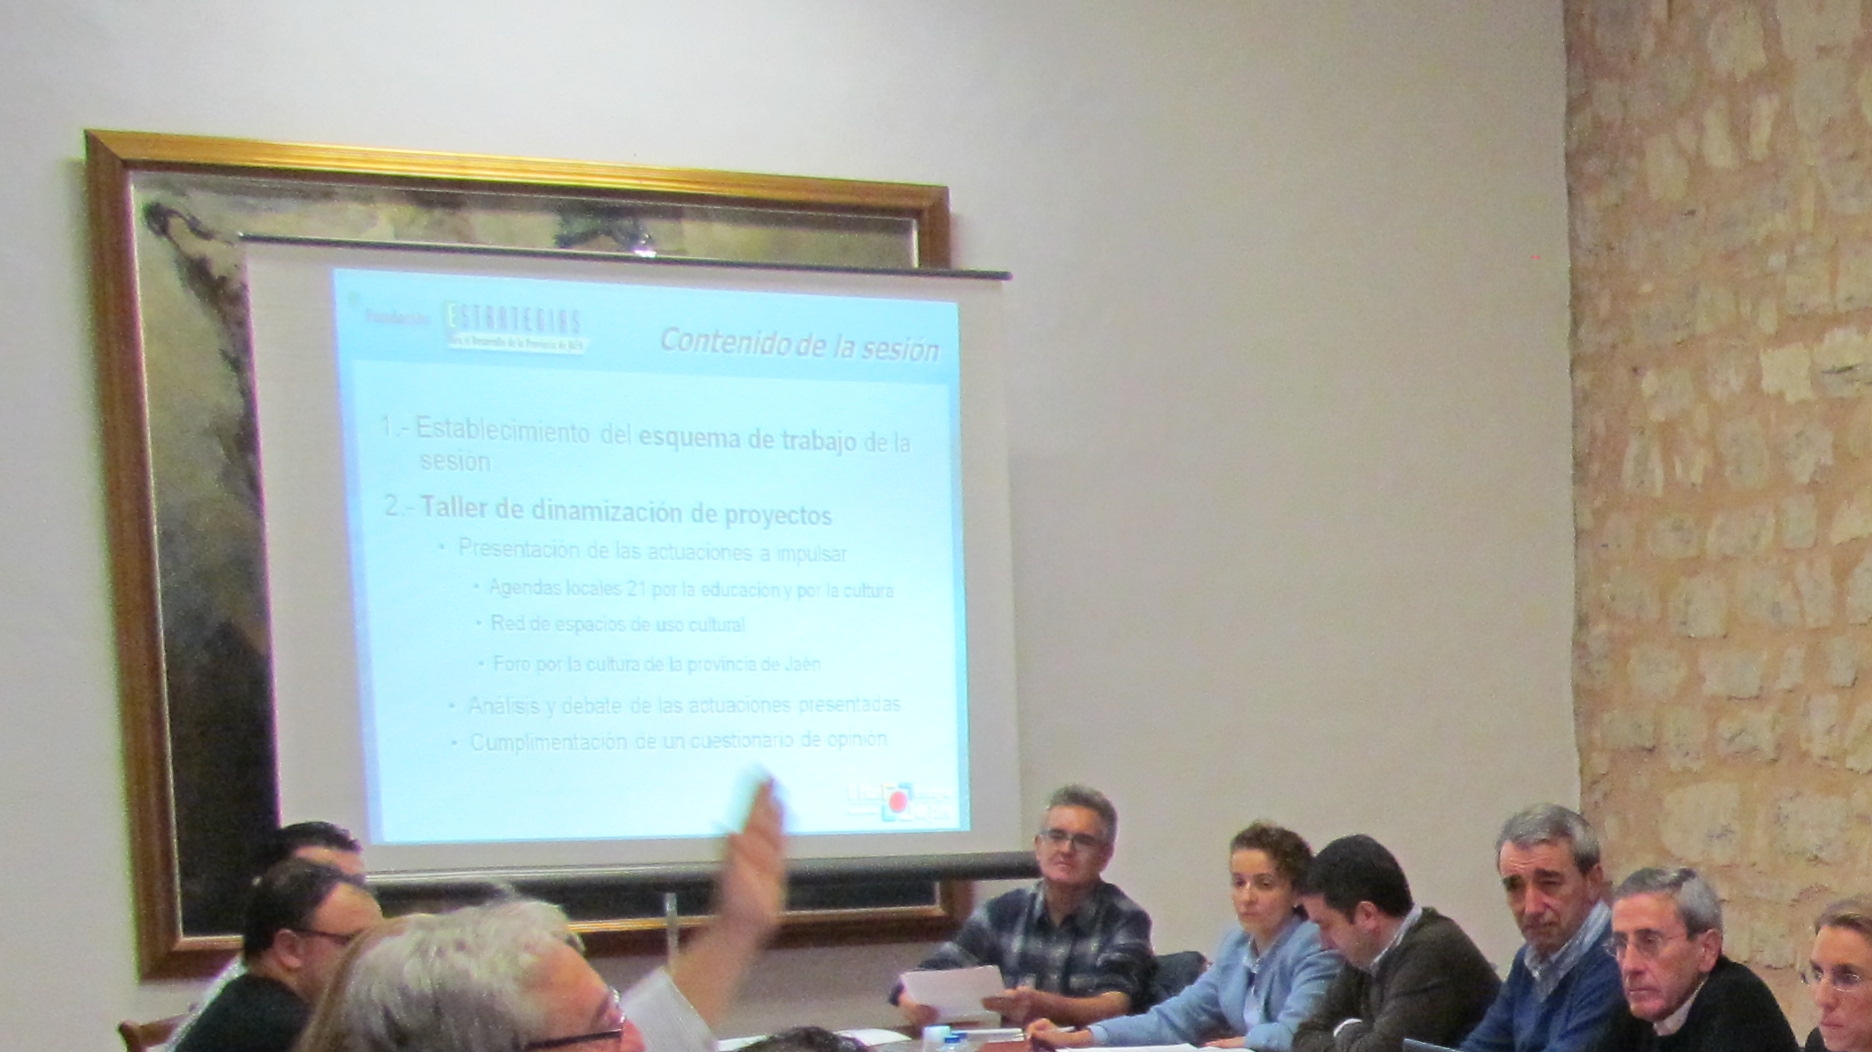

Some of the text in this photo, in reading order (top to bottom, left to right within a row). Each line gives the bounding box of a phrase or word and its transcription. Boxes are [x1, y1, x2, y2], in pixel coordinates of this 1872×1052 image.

[660, 325, 941, 364] Contenido de la sesión
[416, 415, 590, 446] Establecimiento
[600, 421, 632, 446] del
[638, 427, 740, 453] esquema
[748, 426, 775, 451] de
[782, 427, 857, 457] trabajo
[864, 431, 889, 453] de
[893, 431, 911, 454] la
[420, 446, 491, 473] sesión
[420, 494, 489, 520] Taller
[495, 495, 524, 521] de
[531, 497, 683, 524] dinamización
[690, 500, 718, 525] de
[725, 501, 833, 530] proyectos
[459, 535, 848, 567] Presentación de las actuaciones a impulsar
[489, 577, 895, 603] Agendas locales 21 por la educación y por la cultura
[491, 613, 746, 637] Red de espacios de uso cultural
[493, 653, 821, 677] Foro por la cultura de la provincia de Jaén
[467, 694, 901, 720] Análisis y debate de las actuaciones presentadas
[469, 729, 888, 756] Cumplimentación de un cuestionario de opinión
